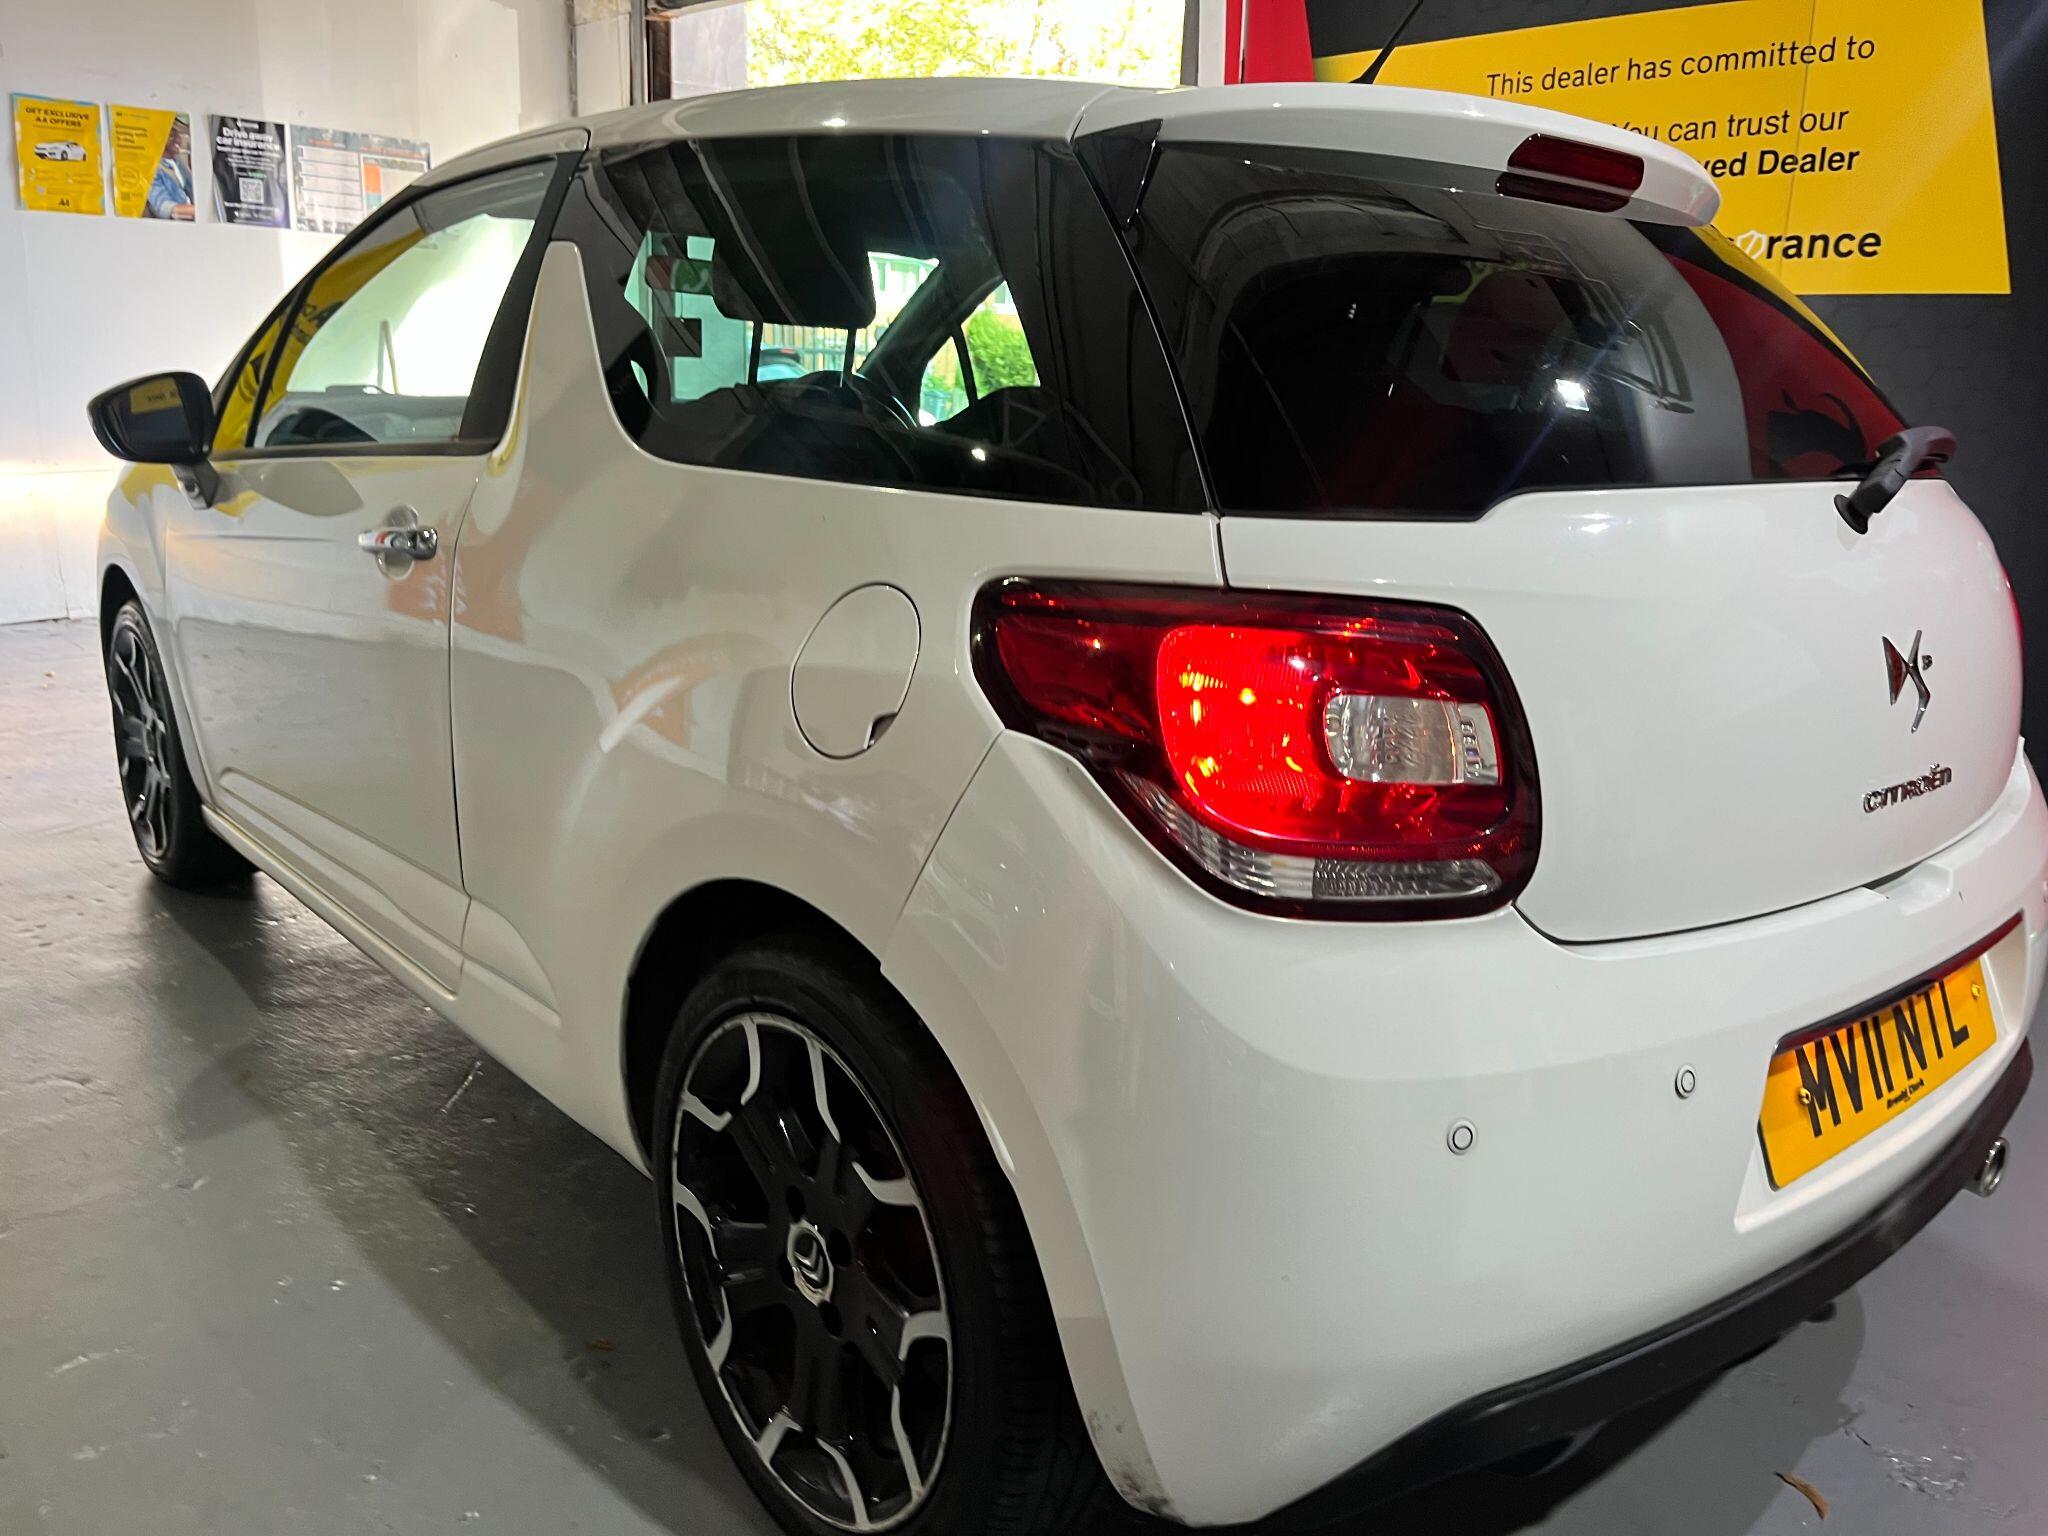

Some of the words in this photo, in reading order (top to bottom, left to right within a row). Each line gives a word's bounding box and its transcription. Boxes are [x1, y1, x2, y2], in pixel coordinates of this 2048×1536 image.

[1486, 70, 1533, 96] This
[1541, 62, 1620, 91] dealer
[1627, 57, 1672, 82] has
[1681, 36, 1836, 76] committed
[1847, 35, 1875, 60] to
[25, 106, 42, 115] GET
[1668, 120, 1716, 142] can
[1728, 110, 1790, 138] trust
[1800, 110, 1849, 133] our
[1758, 147, 1860, 175] Dealer
[1892, 979, 1970, 1080] NTL
